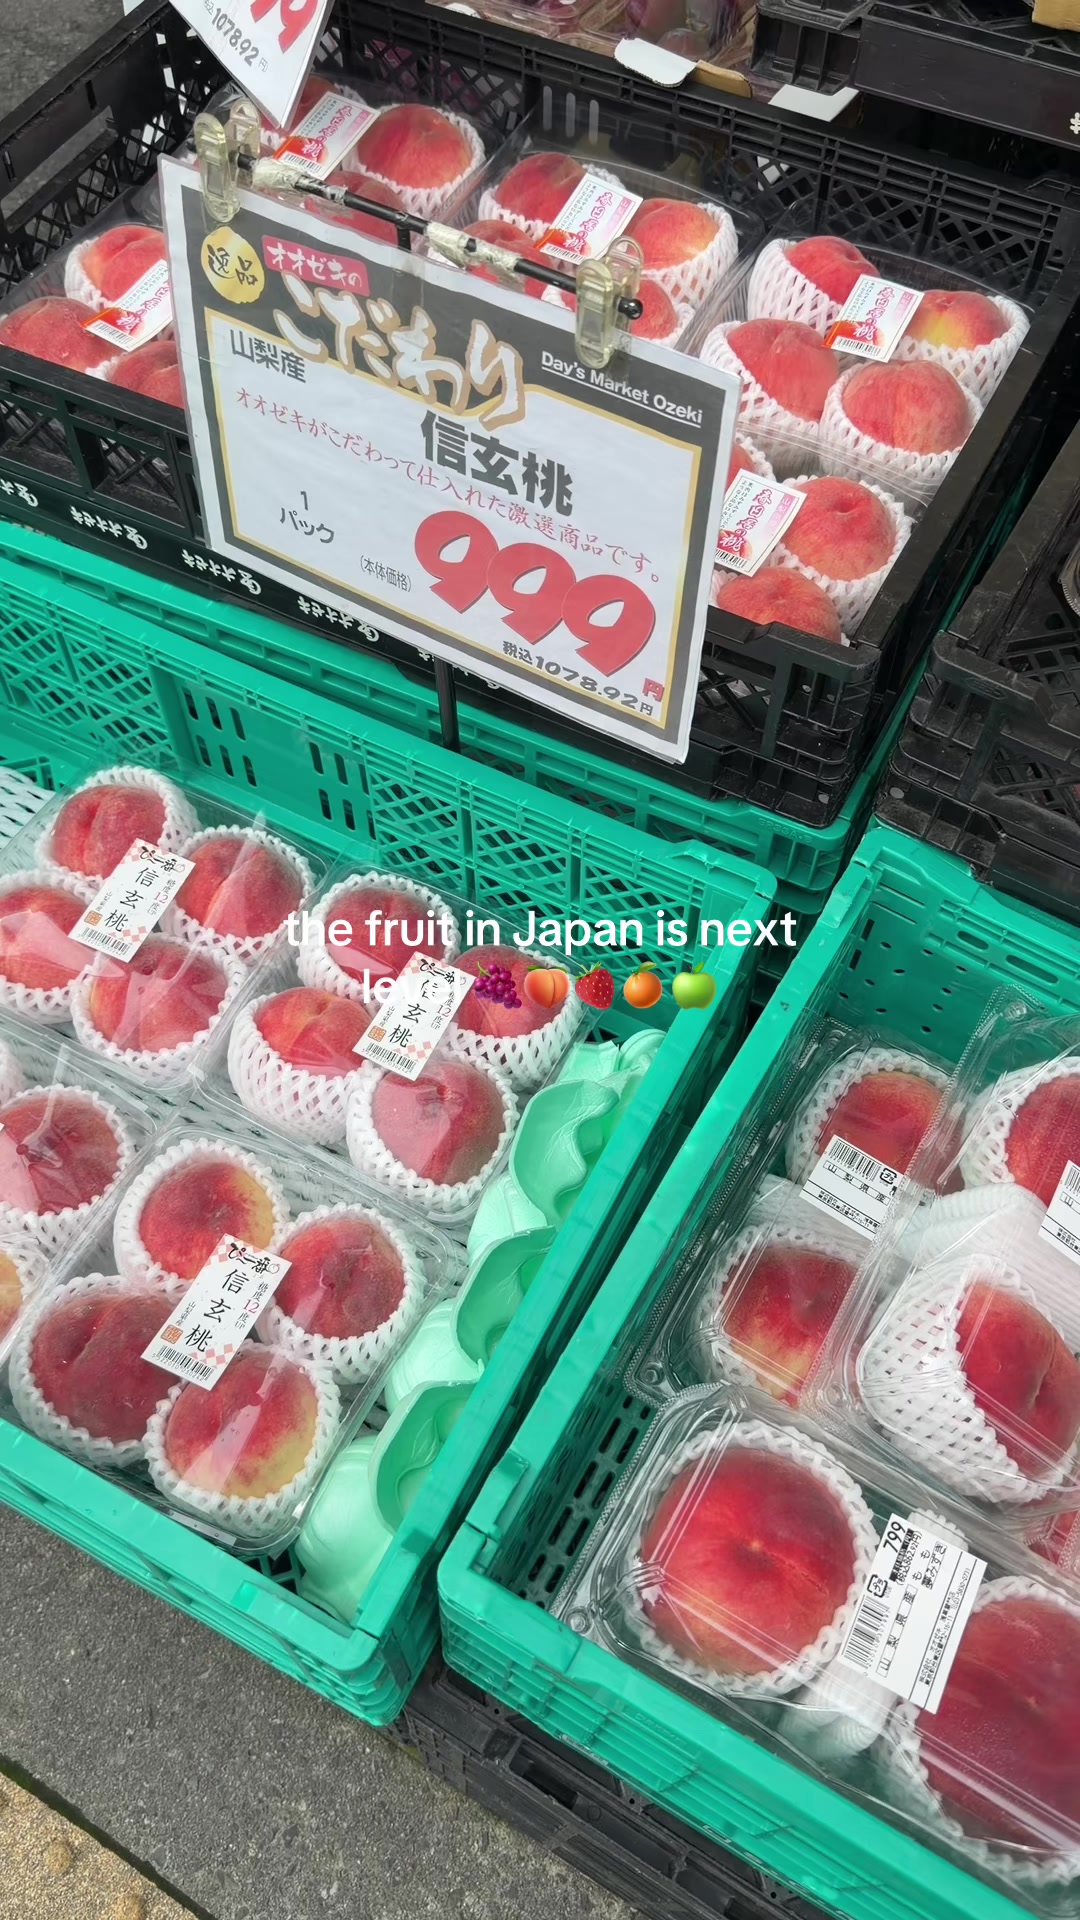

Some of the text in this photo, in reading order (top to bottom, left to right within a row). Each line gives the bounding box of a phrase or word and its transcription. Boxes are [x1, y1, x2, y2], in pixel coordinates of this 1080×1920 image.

[207, 244, 258, 286] 逸品
[267, 243, 362, 287] オオゼキの
[230, 329, 305, 381] 山梨産
[273, 270, 526, 431] こだわり
[541, 351, 702, 424] Day's Market Ozeki
[421, 410, 574, 517] 信玄桃
[280, 507, 335, 544] パック
[300, 491, 309, 511] 1
[360, 555, 412, 592] (本体価格)
[414, 510, 656, 677] 999
[642, 678, 665, 701] 円
[503, 641, 654, 716] 税込1078.92円
[104, 867, 160, 932] 信玄桃
[184, 1268, 250, 1353] 信玄桃
[883, 1521, 906, 1553] 799
[921, 1542, 946, 1590] 夢みずき
